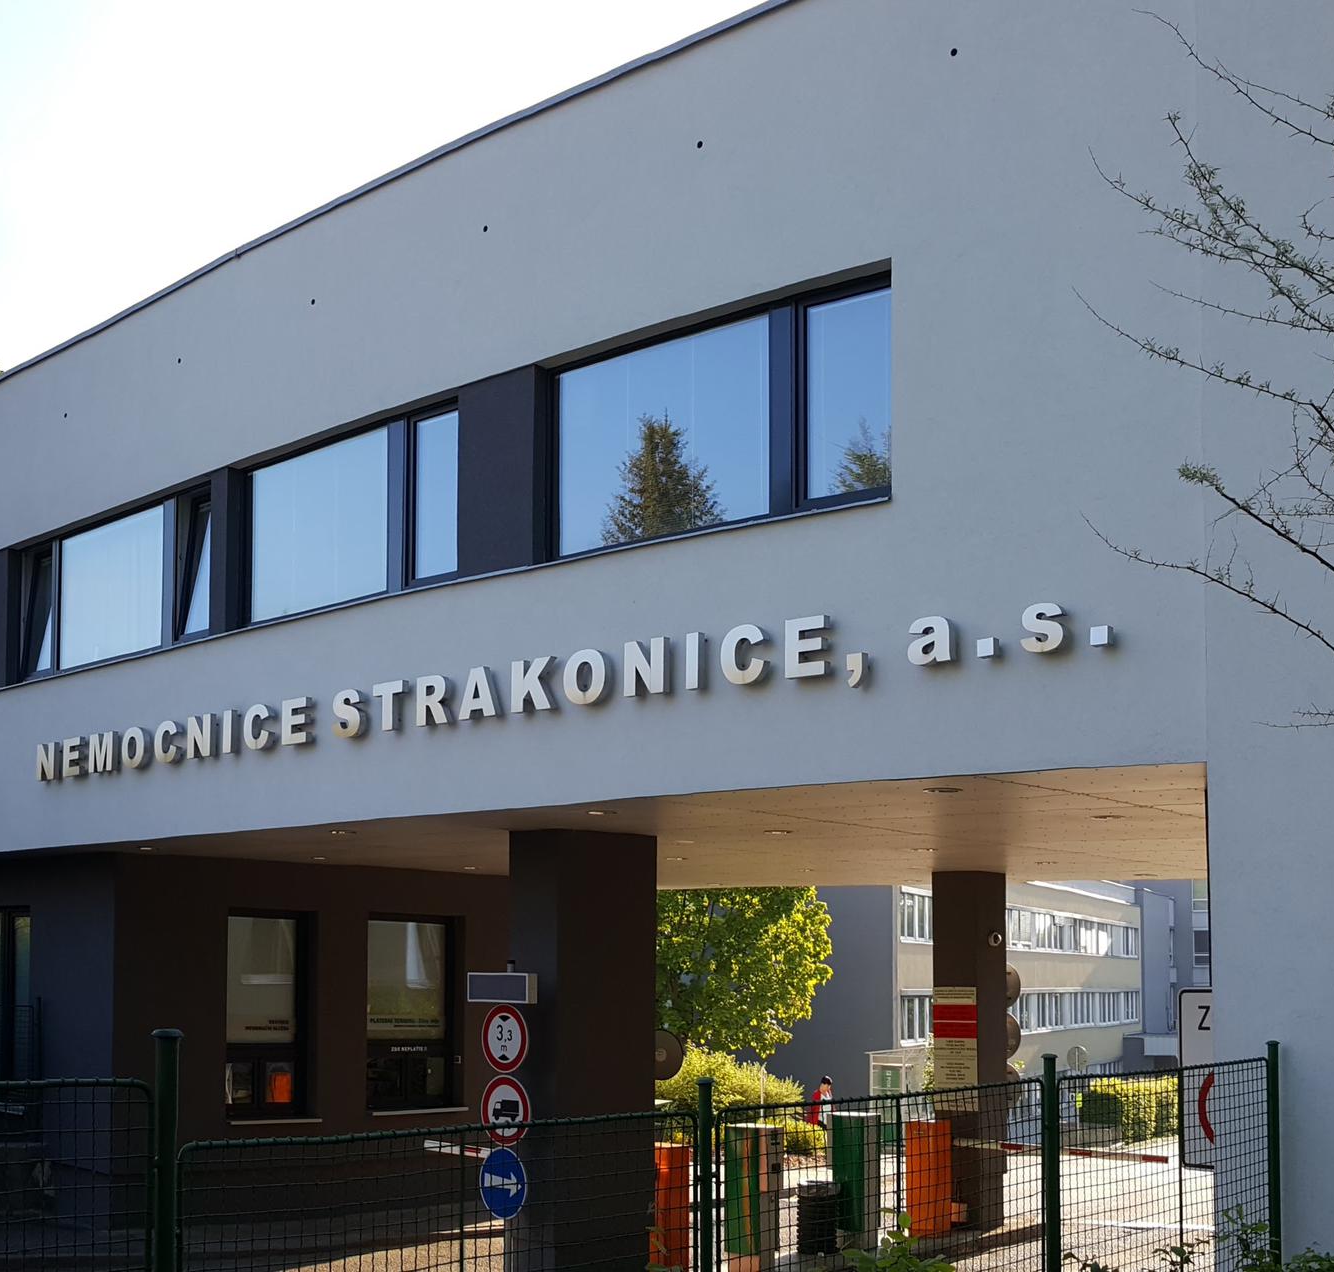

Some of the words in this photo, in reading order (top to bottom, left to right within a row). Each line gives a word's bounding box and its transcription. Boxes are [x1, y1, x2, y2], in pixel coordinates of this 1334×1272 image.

[36, 696, 312, 782] NEMOCNICE
[332, 614, 867, 738] STRAKONICE,
[496, 1024, 513, 1043] 3,3
